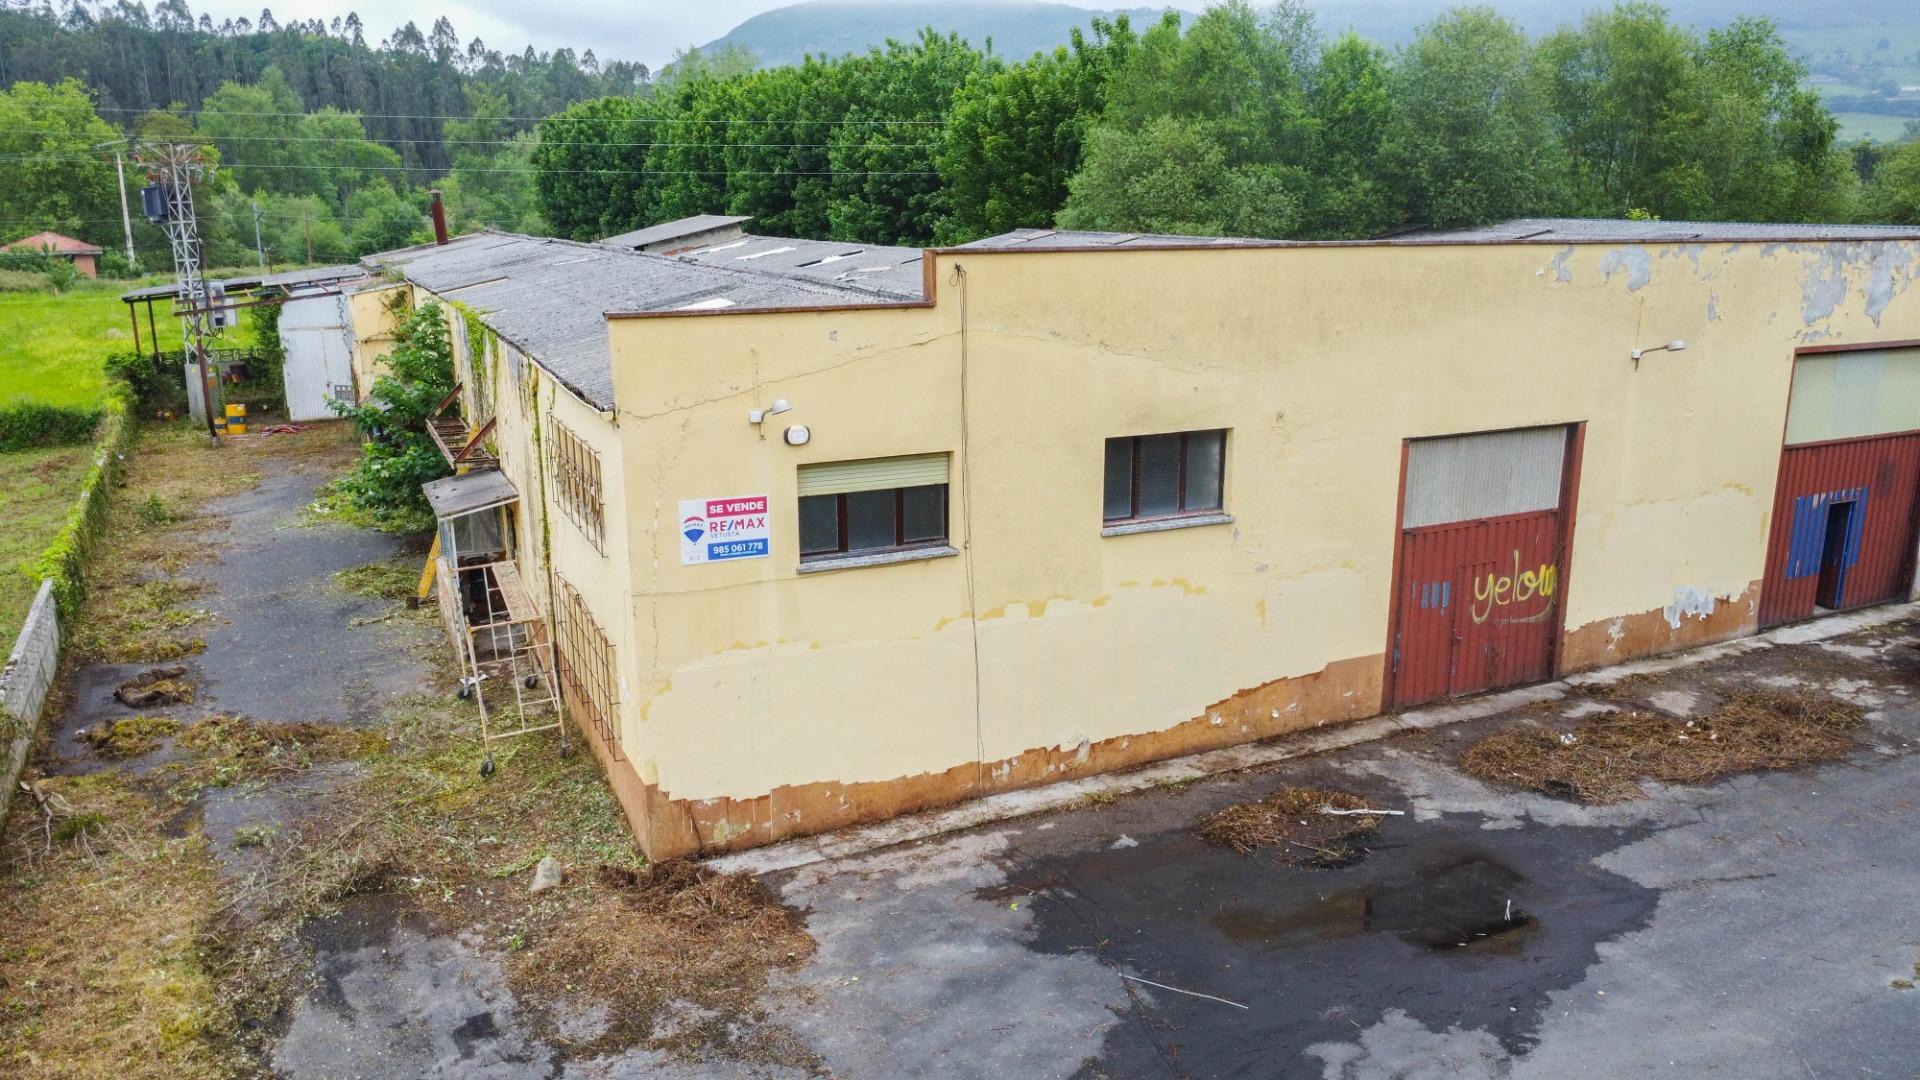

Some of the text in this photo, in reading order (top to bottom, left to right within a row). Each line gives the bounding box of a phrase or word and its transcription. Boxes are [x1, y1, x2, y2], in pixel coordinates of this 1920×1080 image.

[709, 501, 764, 514] SE VENDE
[709, 517, 765, 532] RE/MAX
[710, 531, 740, 539] VETUSTA
[713, 545, 730, 555] 985
[731, 543, 746, 553] 061
[748, 542, 763, 551] 778
